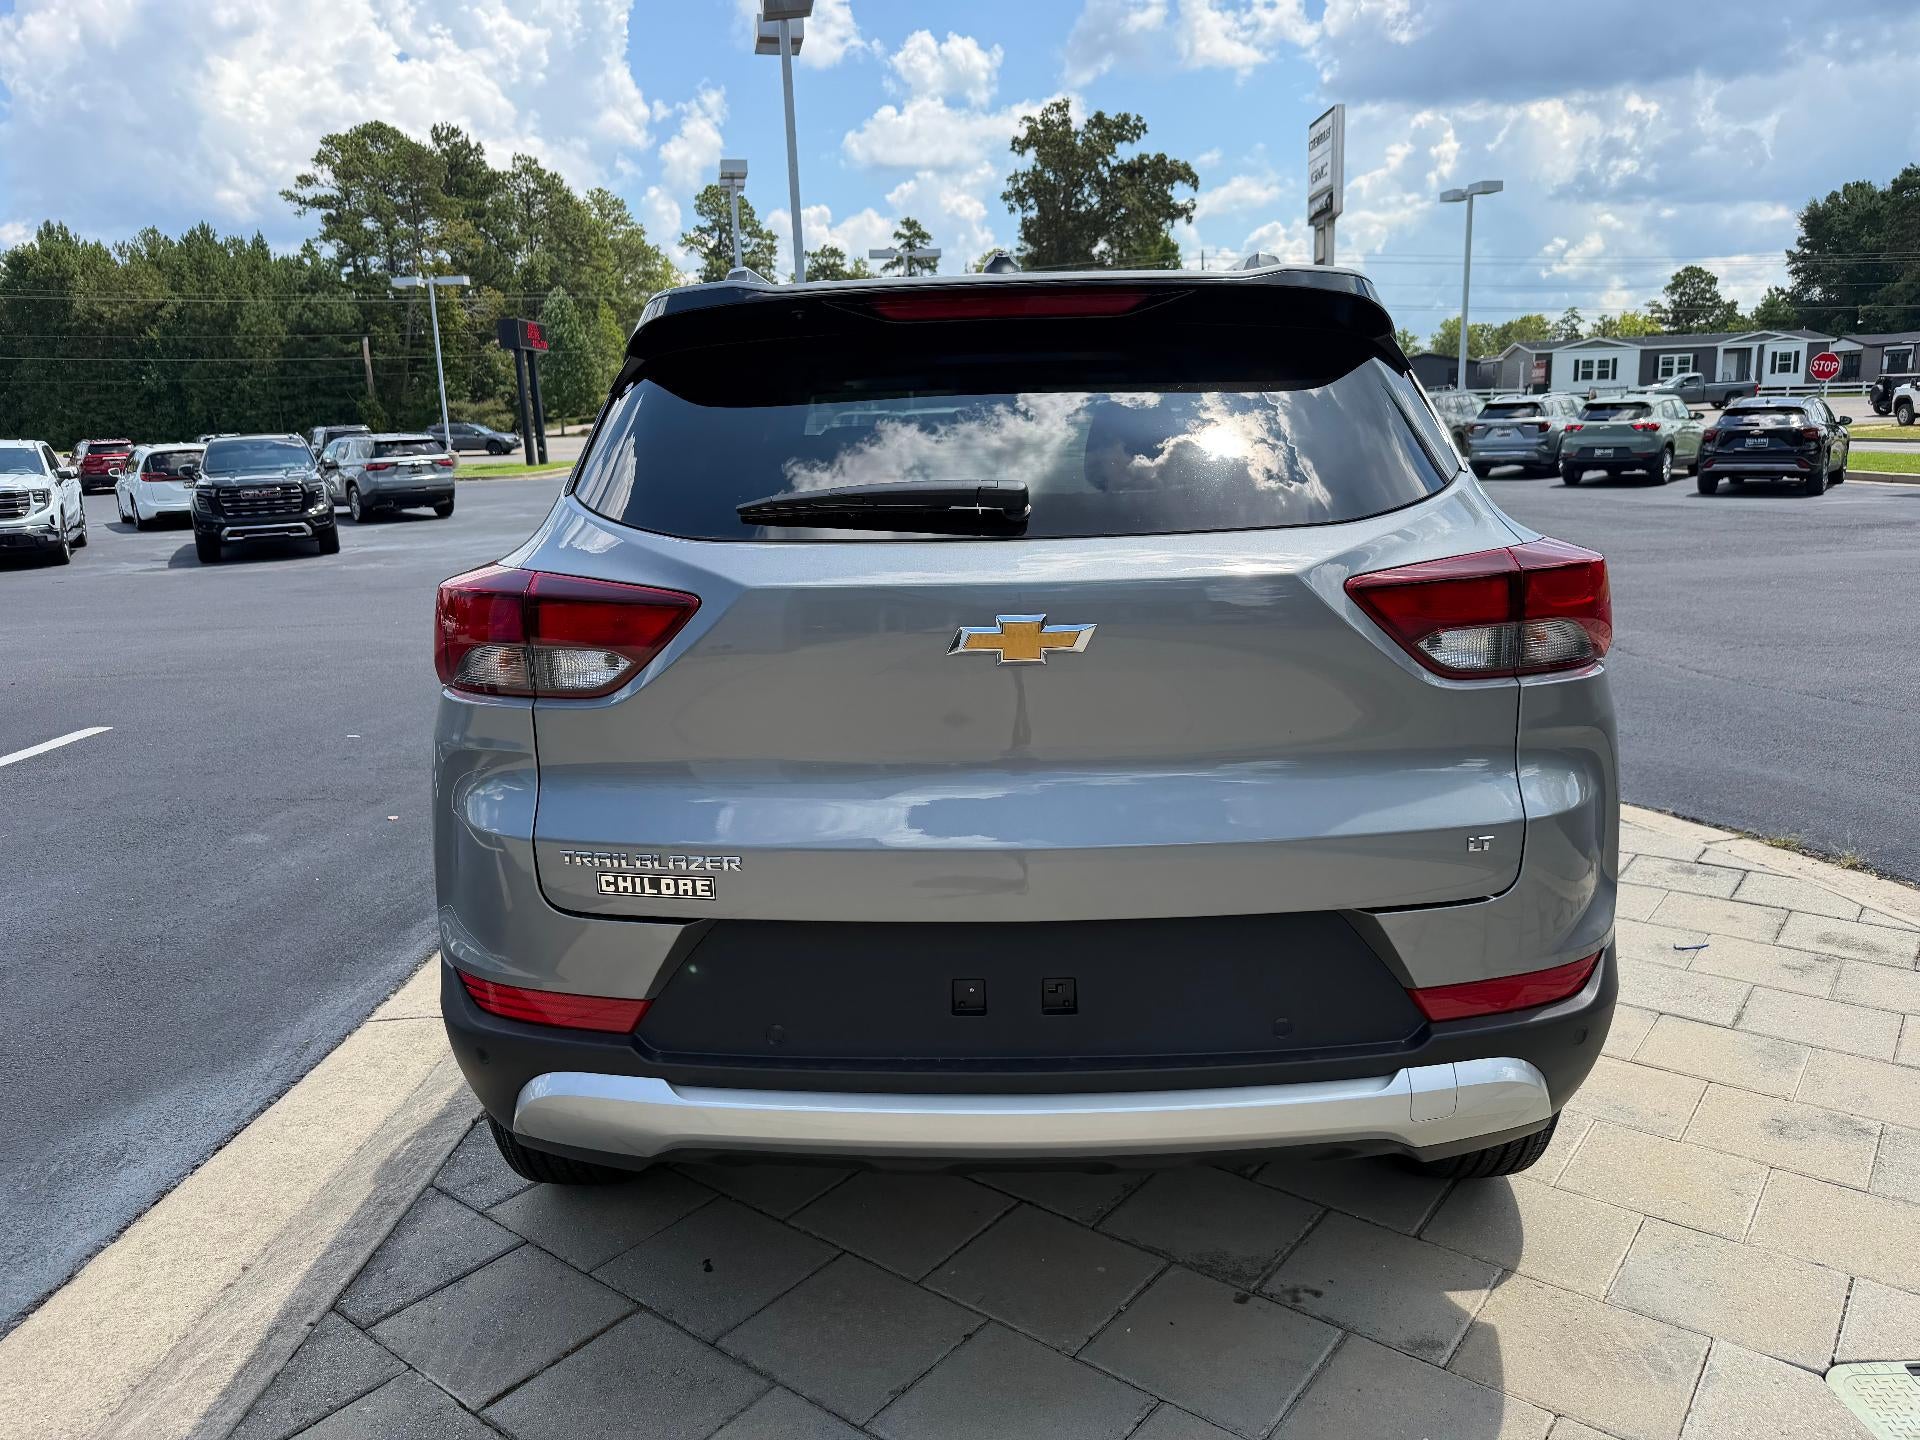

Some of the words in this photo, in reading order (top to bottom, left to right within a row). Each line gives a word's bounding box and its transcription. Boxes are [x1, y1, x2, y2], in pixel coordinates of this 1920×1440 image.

[1812, 360, 1838, 372] STOP
[1467, 835, 1495, 851] LT
[559, 850, 743, 872] TRAILBLAZER
[600, 875, 712, 897] CHILDRE
